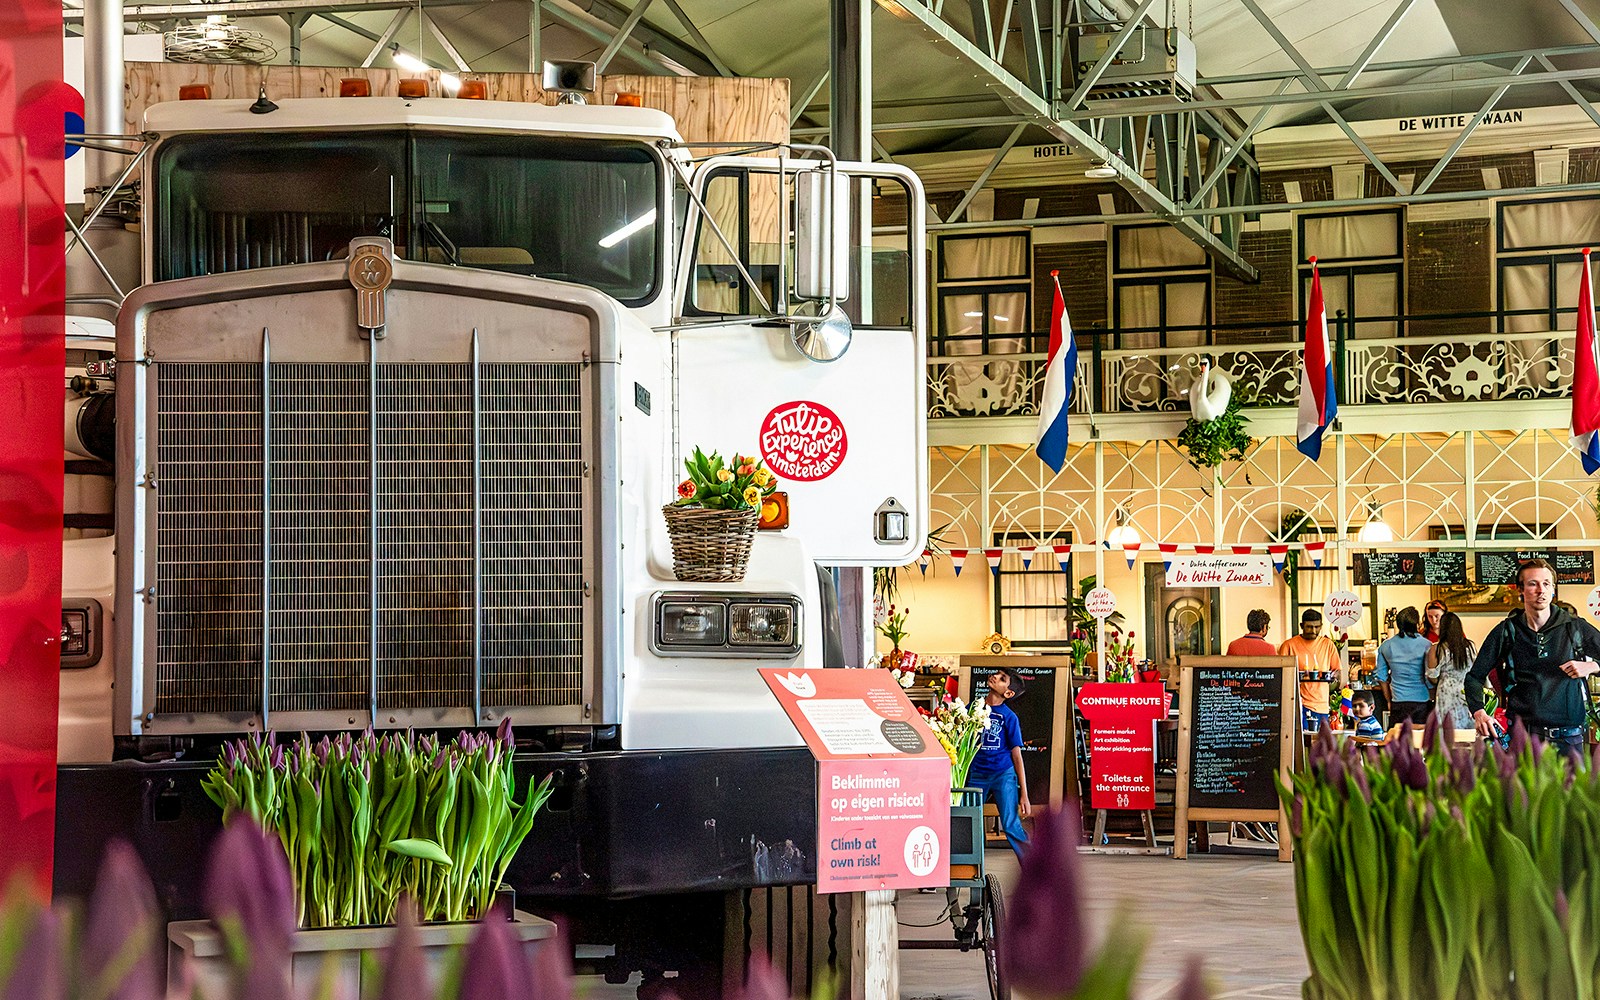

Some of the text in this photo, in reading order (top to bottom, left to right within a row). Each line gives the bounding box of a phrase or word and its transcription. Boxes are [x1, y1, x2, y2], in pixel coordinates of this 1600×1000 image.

[1400, 111, 1523, 131] DE WITTE WAAN
[1034, 145, 1073, 157] HOTEL
[769, 403, 832, 441] Tulip
[762, 425, 843, 458] Experience
[766, 451, 840, 478] Amsterdam
[1190, 560, 1207, 568] Dutch
[1176, 569, 1262, 583] De Witte Zwaan
[1331, 597, 1354, 608] Order
[1335, 607, 1352, 616] here
[973, 667, 998, 675] Welcome
[1081, 697, 1161, 706] CONTINUE ROUTE
[831, 774, 900, 790] Beklimmen
[1102, 774, 1143, 783] Toilets at
[1096, 784, 1150, 793] the entrance
[831, 792, 924, 813] op eigen risico!
[831, 837, 877, 850] Climb at
[830, 854, 880, 868] own risk!
